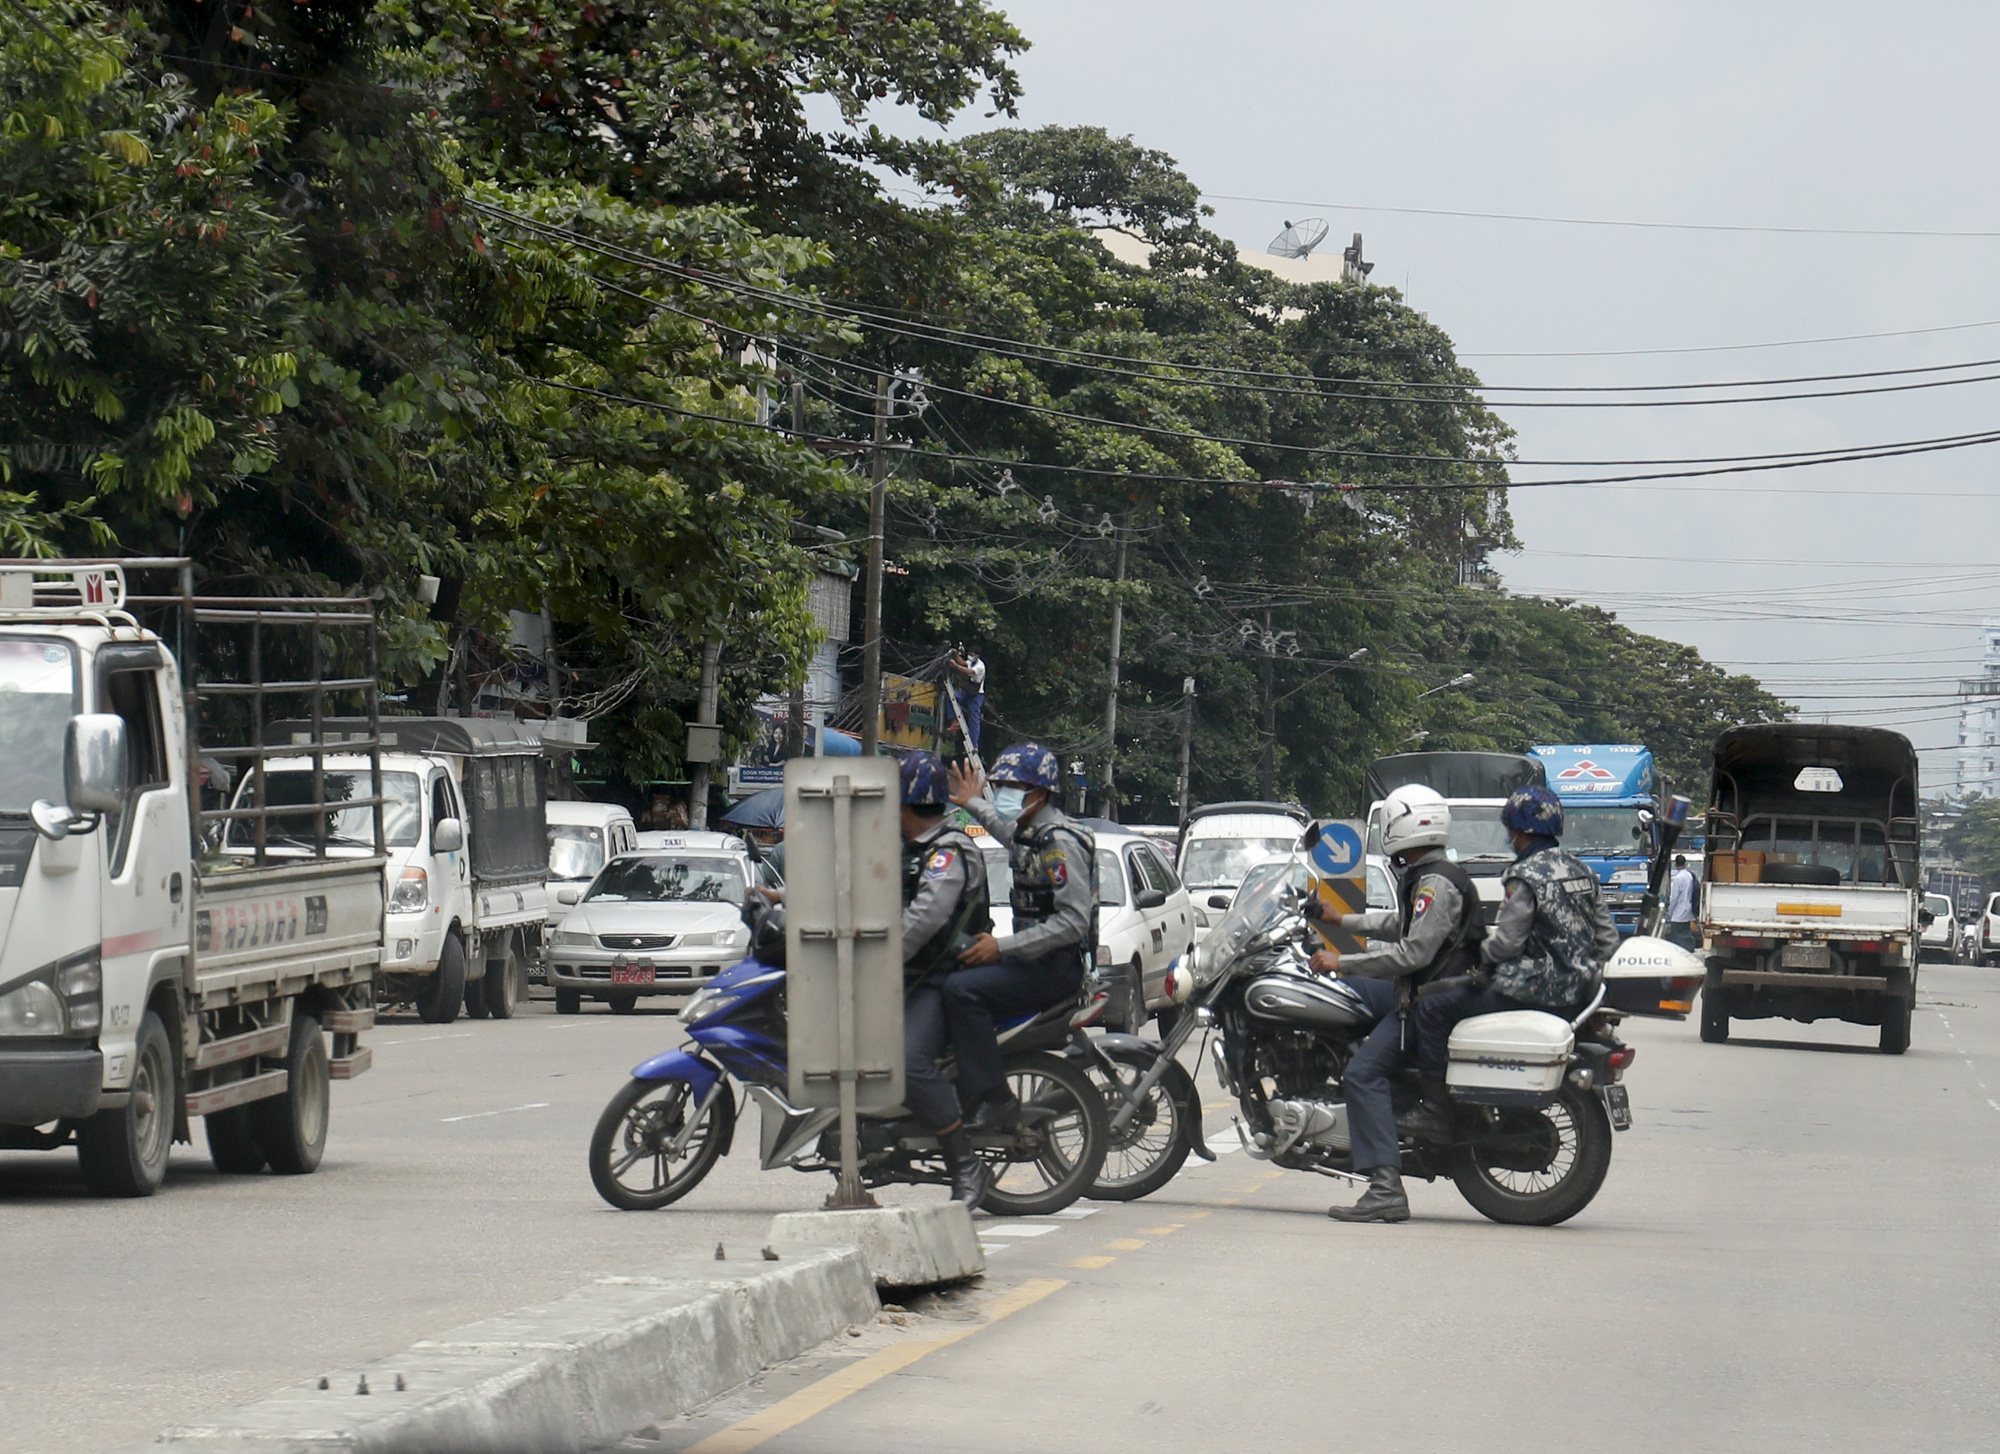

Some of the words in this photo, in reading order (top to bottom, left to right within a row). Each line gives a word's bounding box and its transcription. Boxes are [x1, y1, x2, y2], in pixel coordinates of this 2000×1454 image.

[664, 838, 682, 846] TAXI
[1617, 956, 1673, 967] POLICE
[1478, 1055, 1526, 1072] POLICE
